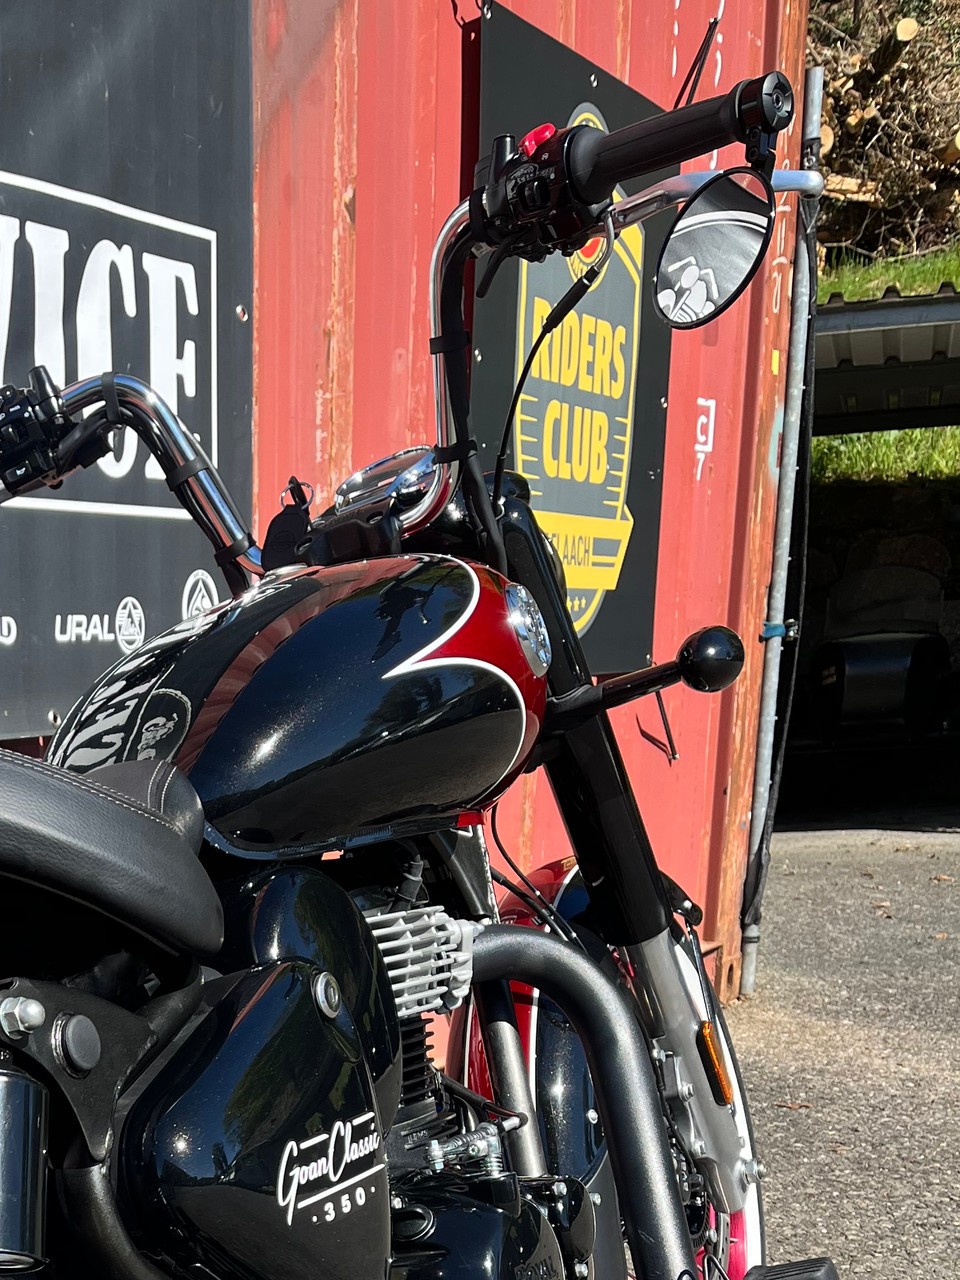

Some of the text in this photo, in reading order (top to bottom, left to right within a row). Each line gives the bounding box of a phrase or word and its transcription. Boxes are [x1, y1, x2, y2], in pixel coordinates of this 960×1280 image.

[530, 296, 626, 399] RIDERS
[543, 399, 609, 485] CLUB
[55, 614, 115, 642] URAL
